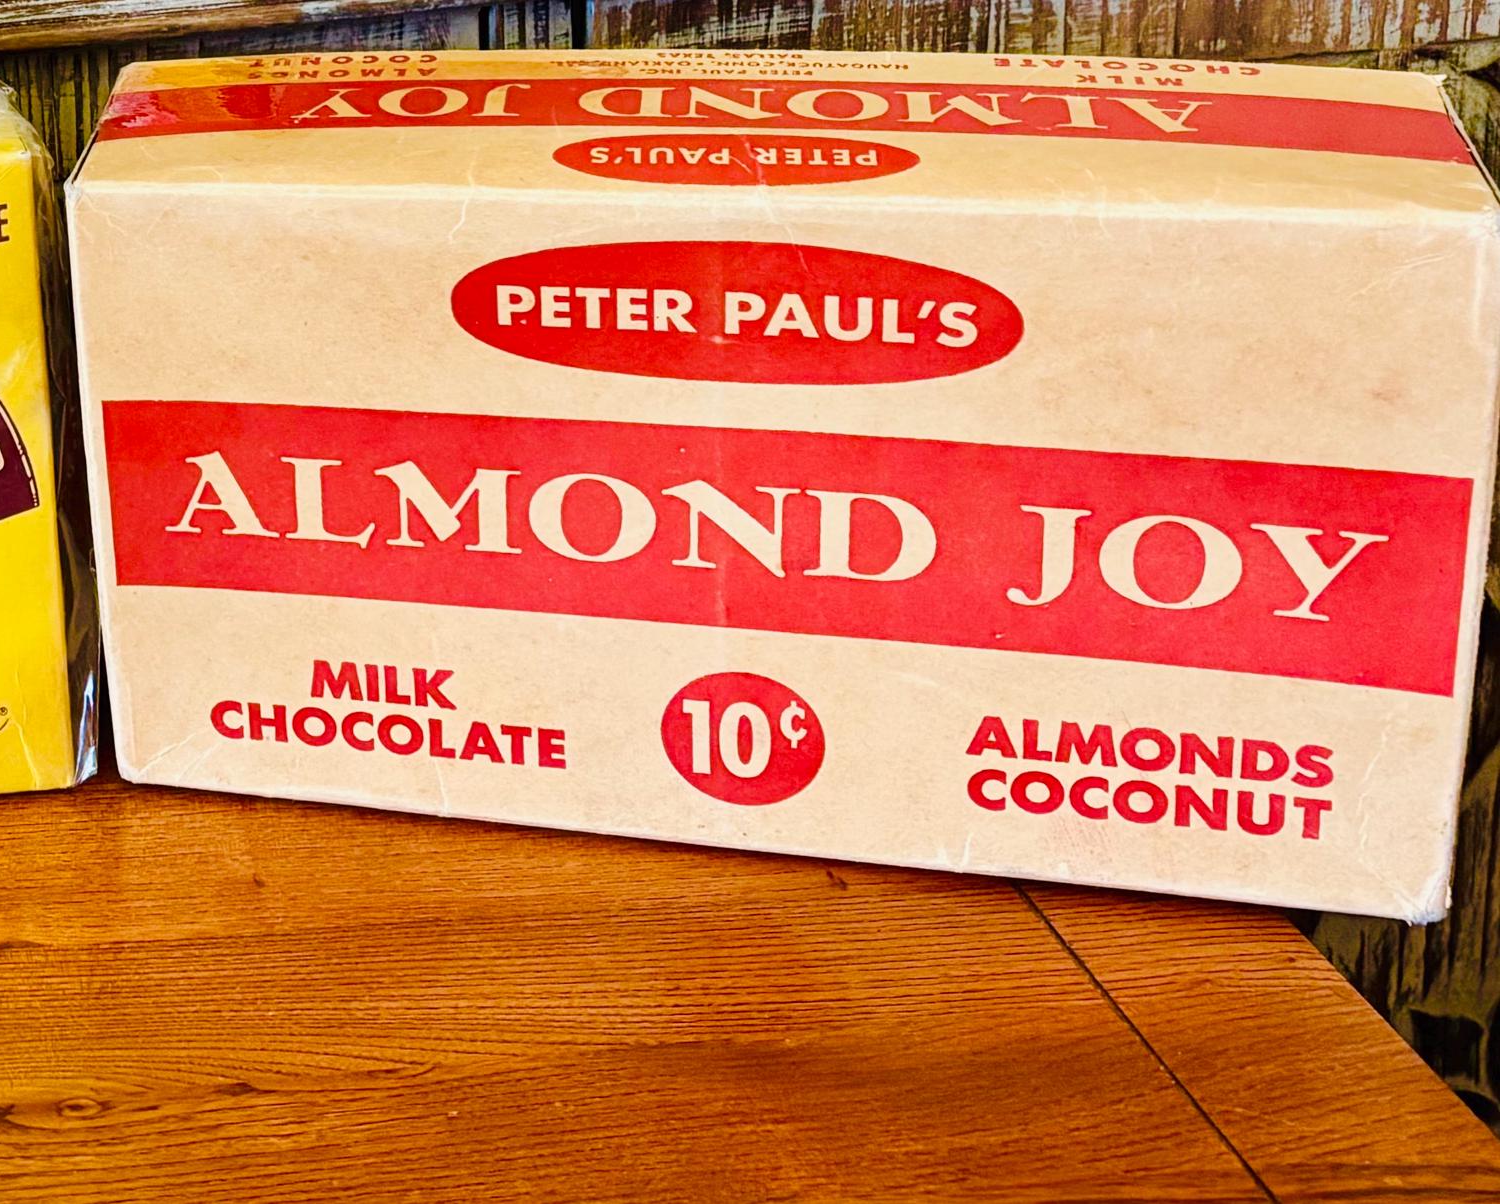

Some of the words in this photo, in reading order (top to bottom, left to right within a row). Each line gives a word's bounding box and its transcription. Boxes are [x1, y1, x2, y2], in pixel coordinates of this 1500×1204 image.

[248, 68, 437, 79] ALMONDS
[249, 54, 438, 67] COCONUT
[993, 57, 1261, 76] CHOCOLATE
[1076, 74, 1184, 86] MILK
[291, 83, 531, 118] JOY
[578, 84, 1213, 133] ALMOND
[591, 147, 731, 166] PAUL'S
[747, 147, 879, 166] PETER
[495, 284, 698, 335] PETER
[723, 291, 980, 348] PAUL'S
[164, 449, 937, 582] ALMOND
[1006, 503, 1390, 624] JOY
[310, 658, 457, 711] MILK
[210, 699, 567, 769] CHOCOLATE
[966, 715, 1334, 788] ALMONDS
[967, 769, 1333, 841] COCONUT
